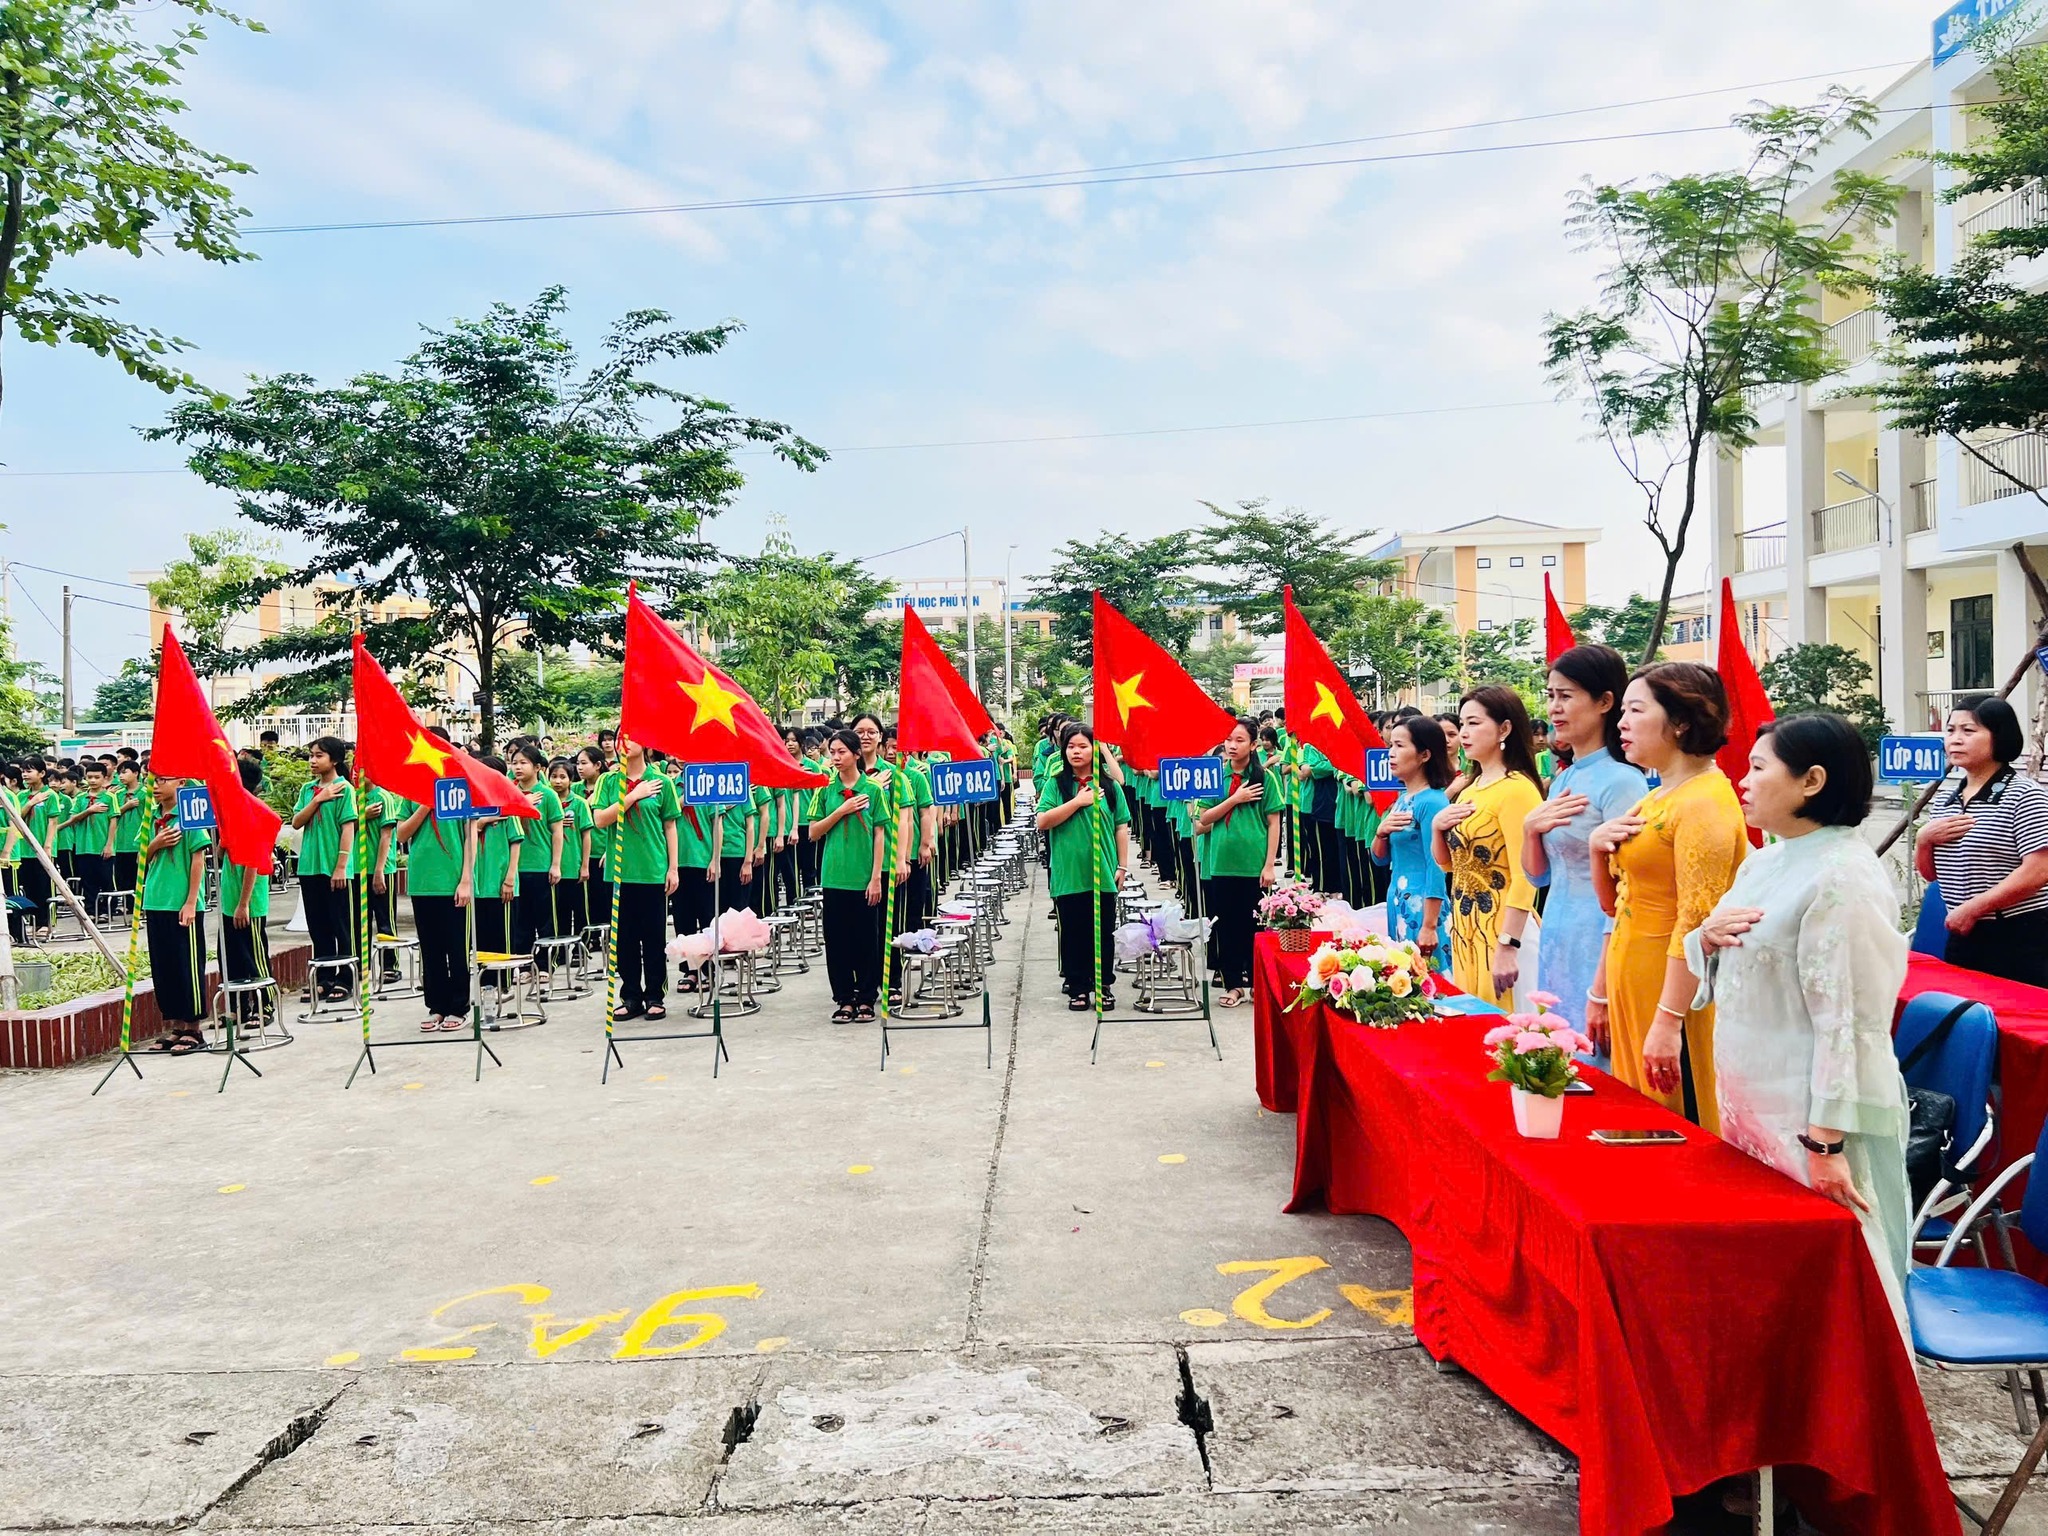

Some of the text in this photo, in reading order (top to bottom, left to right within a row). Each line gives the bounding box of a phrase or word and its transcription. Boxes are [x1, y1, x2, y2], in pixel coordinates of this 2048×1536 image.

[918, 597, 936, 610] HỌC
[940, 593, 958, 607] PHÚ
[961, 596, 979, 606] YN
[1885, 742, 1939, 770] LỚP 9A1
[689, 768, 743, 796] LỚP 8A3
[937, 767, 991, 795] LỚP 8A2
[1165, 763, 1218, 790] LỚP 8A1
[183, 792, 208, 821] LỚP
[440, 783, 466, 811] LỚP
